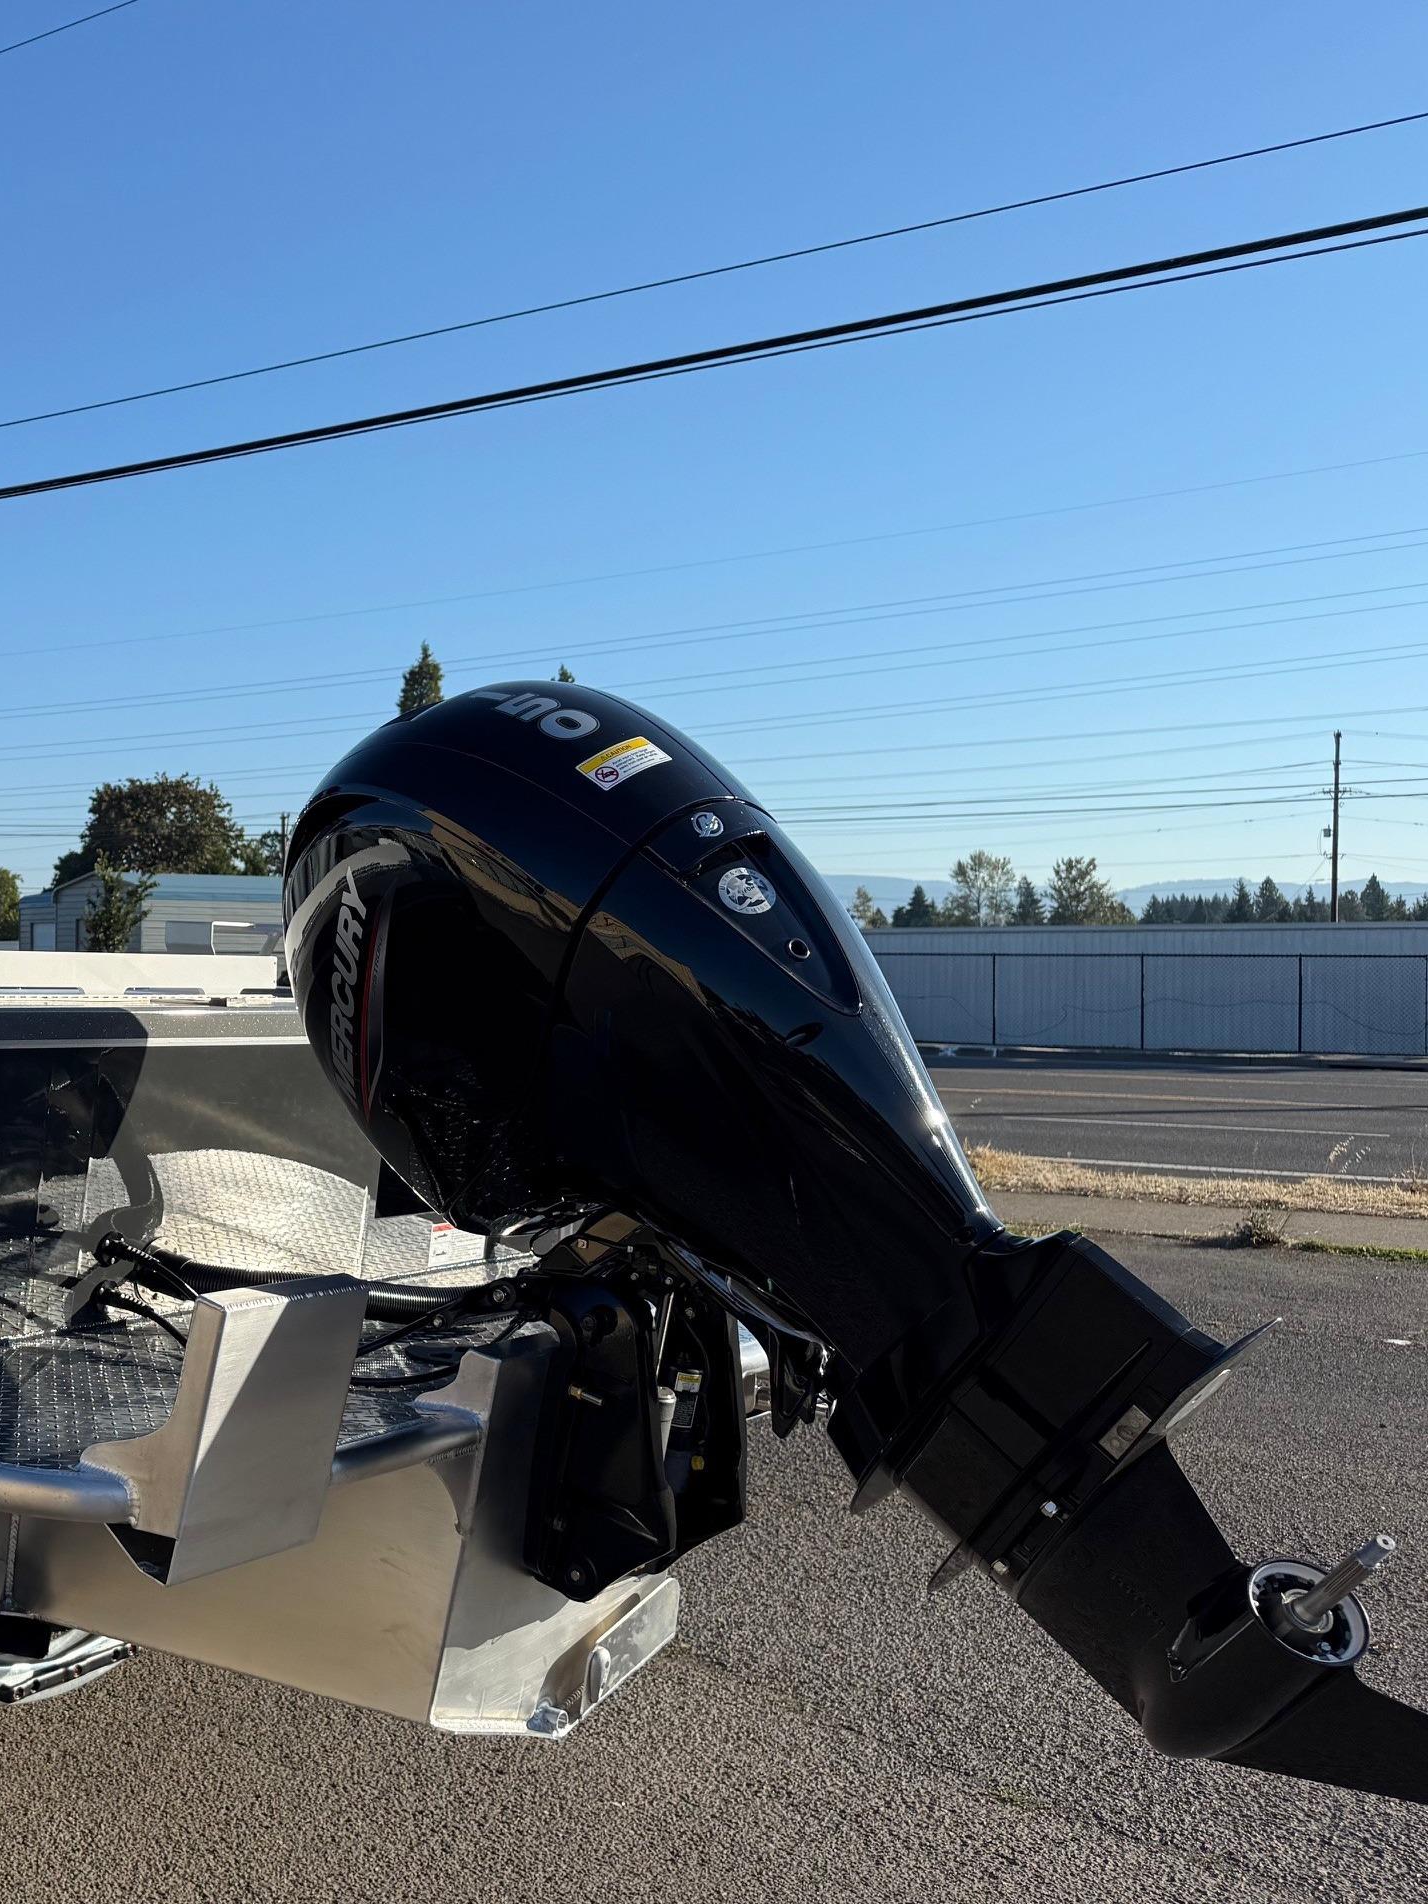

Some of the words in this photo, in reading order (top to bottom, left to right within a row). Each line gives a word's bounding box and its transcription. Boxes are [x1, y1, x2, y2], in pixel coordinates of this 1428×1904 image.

[470, 690, 601, 740] 150
[605, 743, 633, 758] CAUTION
[330, 866, 367, 1110] MERCURY
